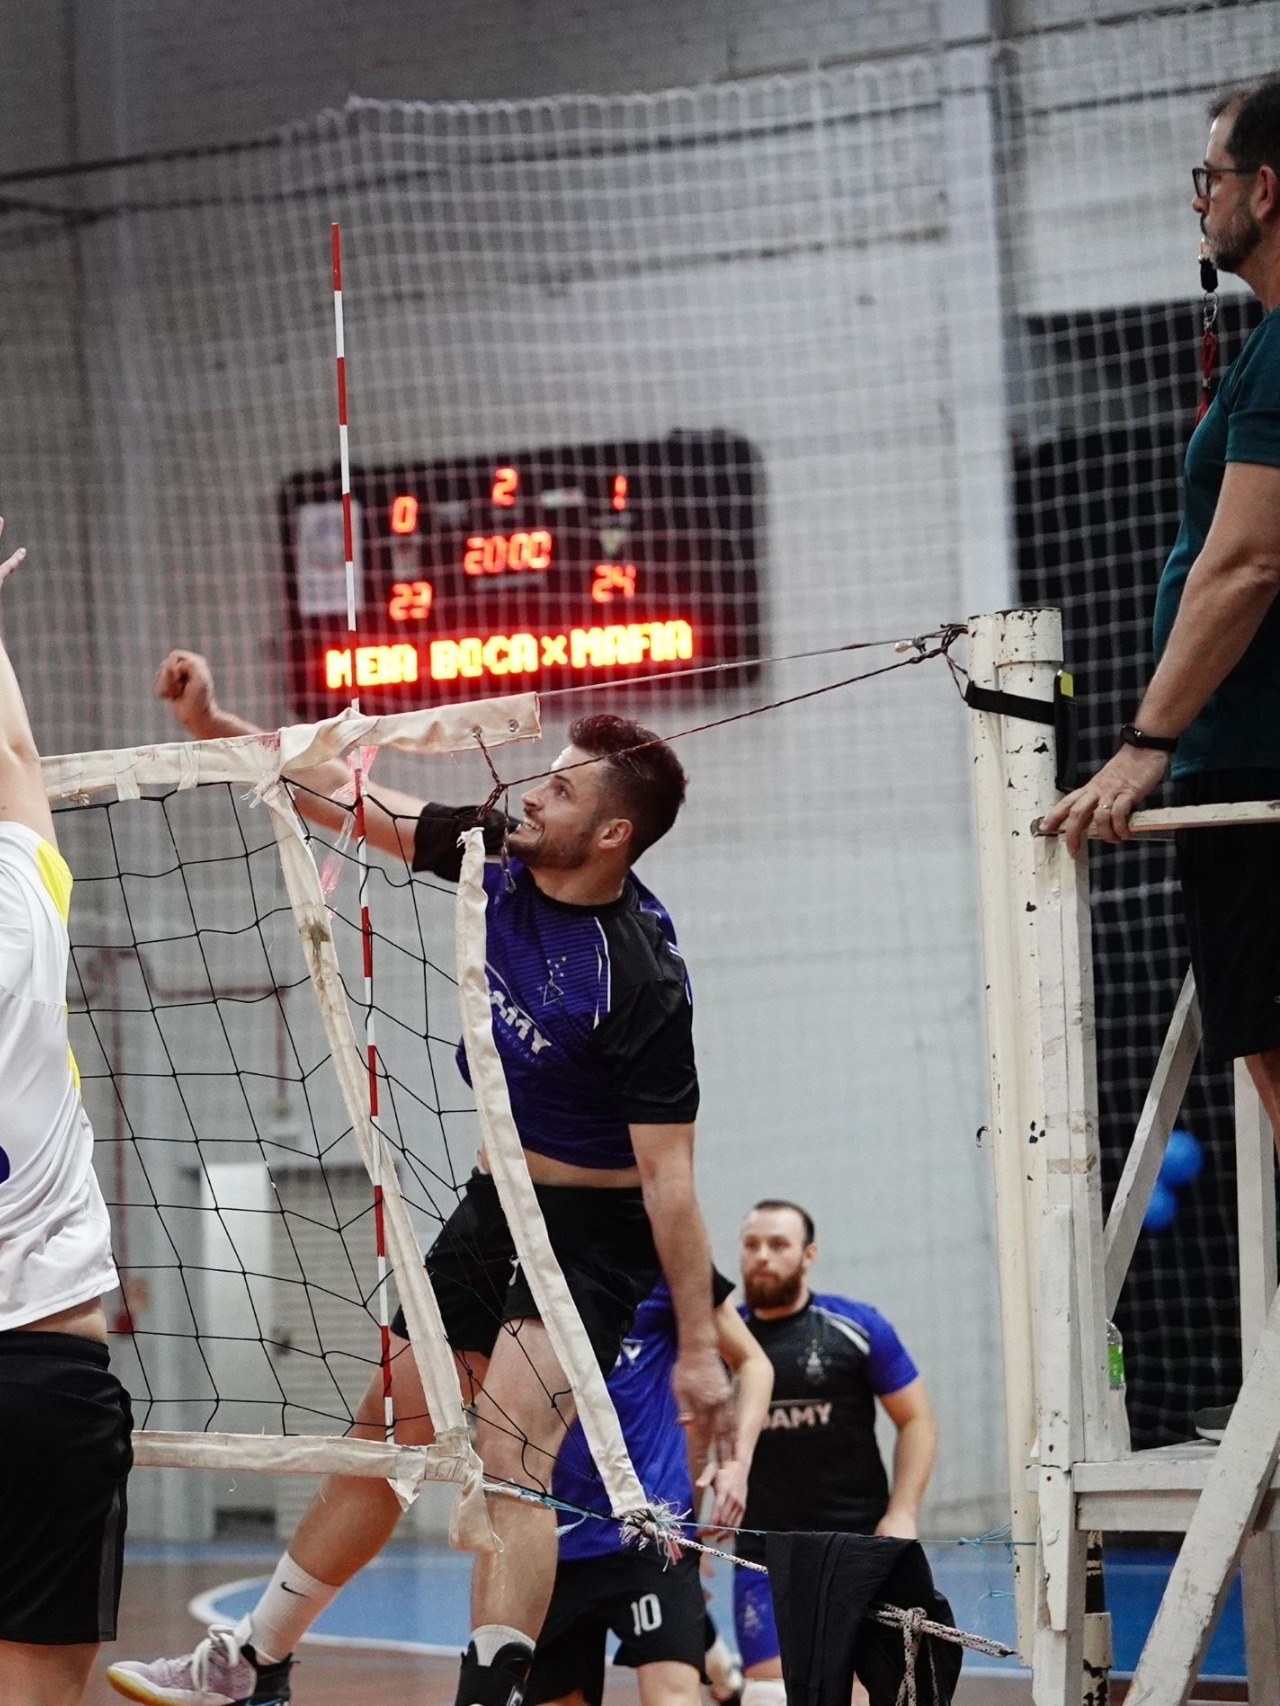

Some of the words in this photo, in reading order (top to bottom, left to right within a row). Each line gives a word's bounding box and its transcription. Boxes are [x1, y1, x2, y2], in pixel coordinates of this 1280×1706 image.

[491, 467, 518, 506] 2
[612, 474, 627, 510] 1
[391, 495, 418, 534] 0
[389, 581, 432, 620] 23
[591, 563, 636, 603] 24
[429, 632, 539, 681] BOCA
[569, 619, 693, 669] MAFIA
[630, 1594, 662, 1637] 10
